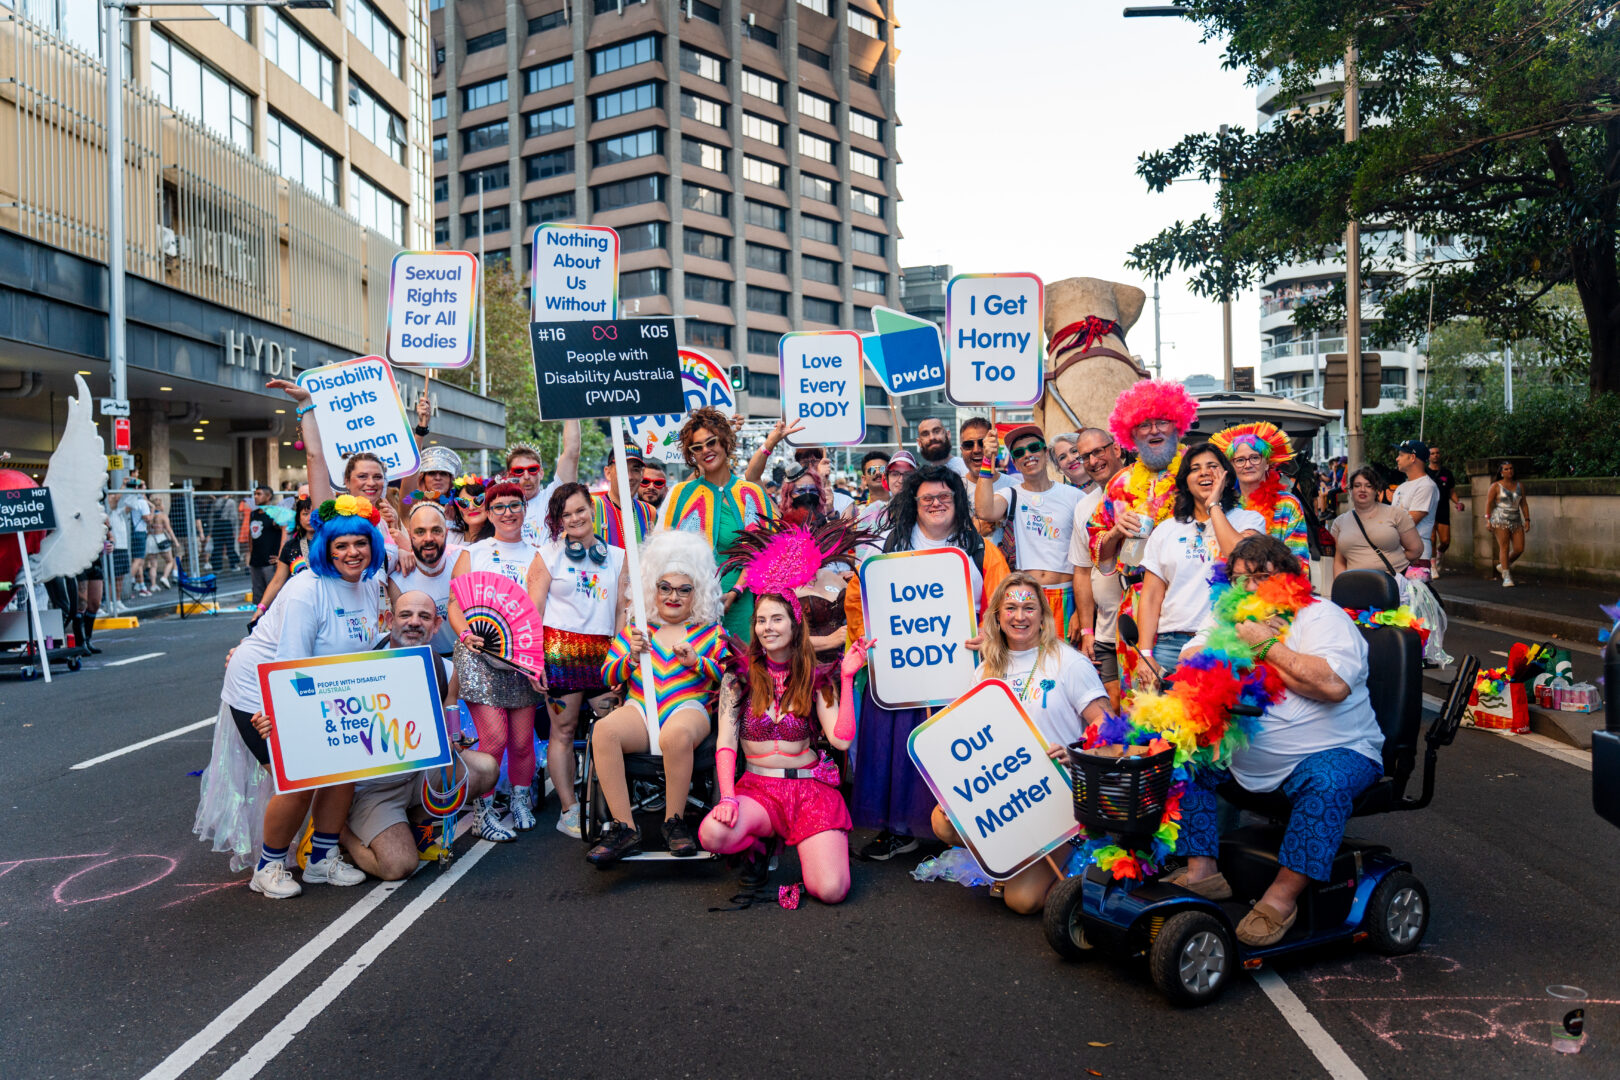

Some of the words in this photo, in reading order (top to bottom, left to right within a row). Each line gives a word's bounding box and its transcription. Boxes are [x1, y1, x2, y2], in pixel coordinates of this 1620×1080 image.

[547, 231, 609, 252] Nothing
[553, 253, 601, 270] About
[405, 266, 462, 281] Sexual
[566, 276, 587, 290] Us
[407, 288, 457, 306] Rights
[545, 296, 607, 313] Without
[970, 295, 976, 316] I
[983, 294, 1028, 316] Get
[404, 311, 432, 326] For
[435, 311, 457, 326] All
[401, 333, 457, 349] Bodies
[538, 327, 566, 342] #16
[640, 325, 669, 339] K05
[958, 328, 1031, 353] Horny
[227, 329, 297, 380] HYDE
[567, 349, 617, 365] People
[618, 347, 649, 361] with
[802, 353, 843, 369] Love
[544, 370, 610, 386] Disability
[613, 368, 675, 382] Australia
[680, 356, 709, 380] re
[891, 364, 942, 390] pwda
[971, 361, 1016, 382] Too
[306, 366, 383, 394] Disability
[800, 378, 847, 396] Every
[329, 390, 378, 412] rights
[585, 388, 640, 406] (PWDA)
[799, 401, 850, 418] BODY
[346, 415, 376, 431] are
[336, 432, 398, 457] human
[31, 489, 47, 497] H07
[0, 500, 45, 516] ayside
[890, 582, 944, 603] Love
[890, 614, 952, 637] Every
[890, 642, 958, 669] BODY
[317, 680, 340, 689] PEOPLE
[356, 674, 386, 684] DISABILITY
[318, 686, 351, 694] AUSTRALIA
[320, 693, 391, 718] PROUD
[325, 719, 338, 733] &
[340, 716, 370, 731] free
[327, 735, 340, 747] to
[343, 733, 359, 745] be
[950, 723, 995, 763] Our
[952, 745, 1032, 803] Voices
[974, 774, 1053, 839] Matter
